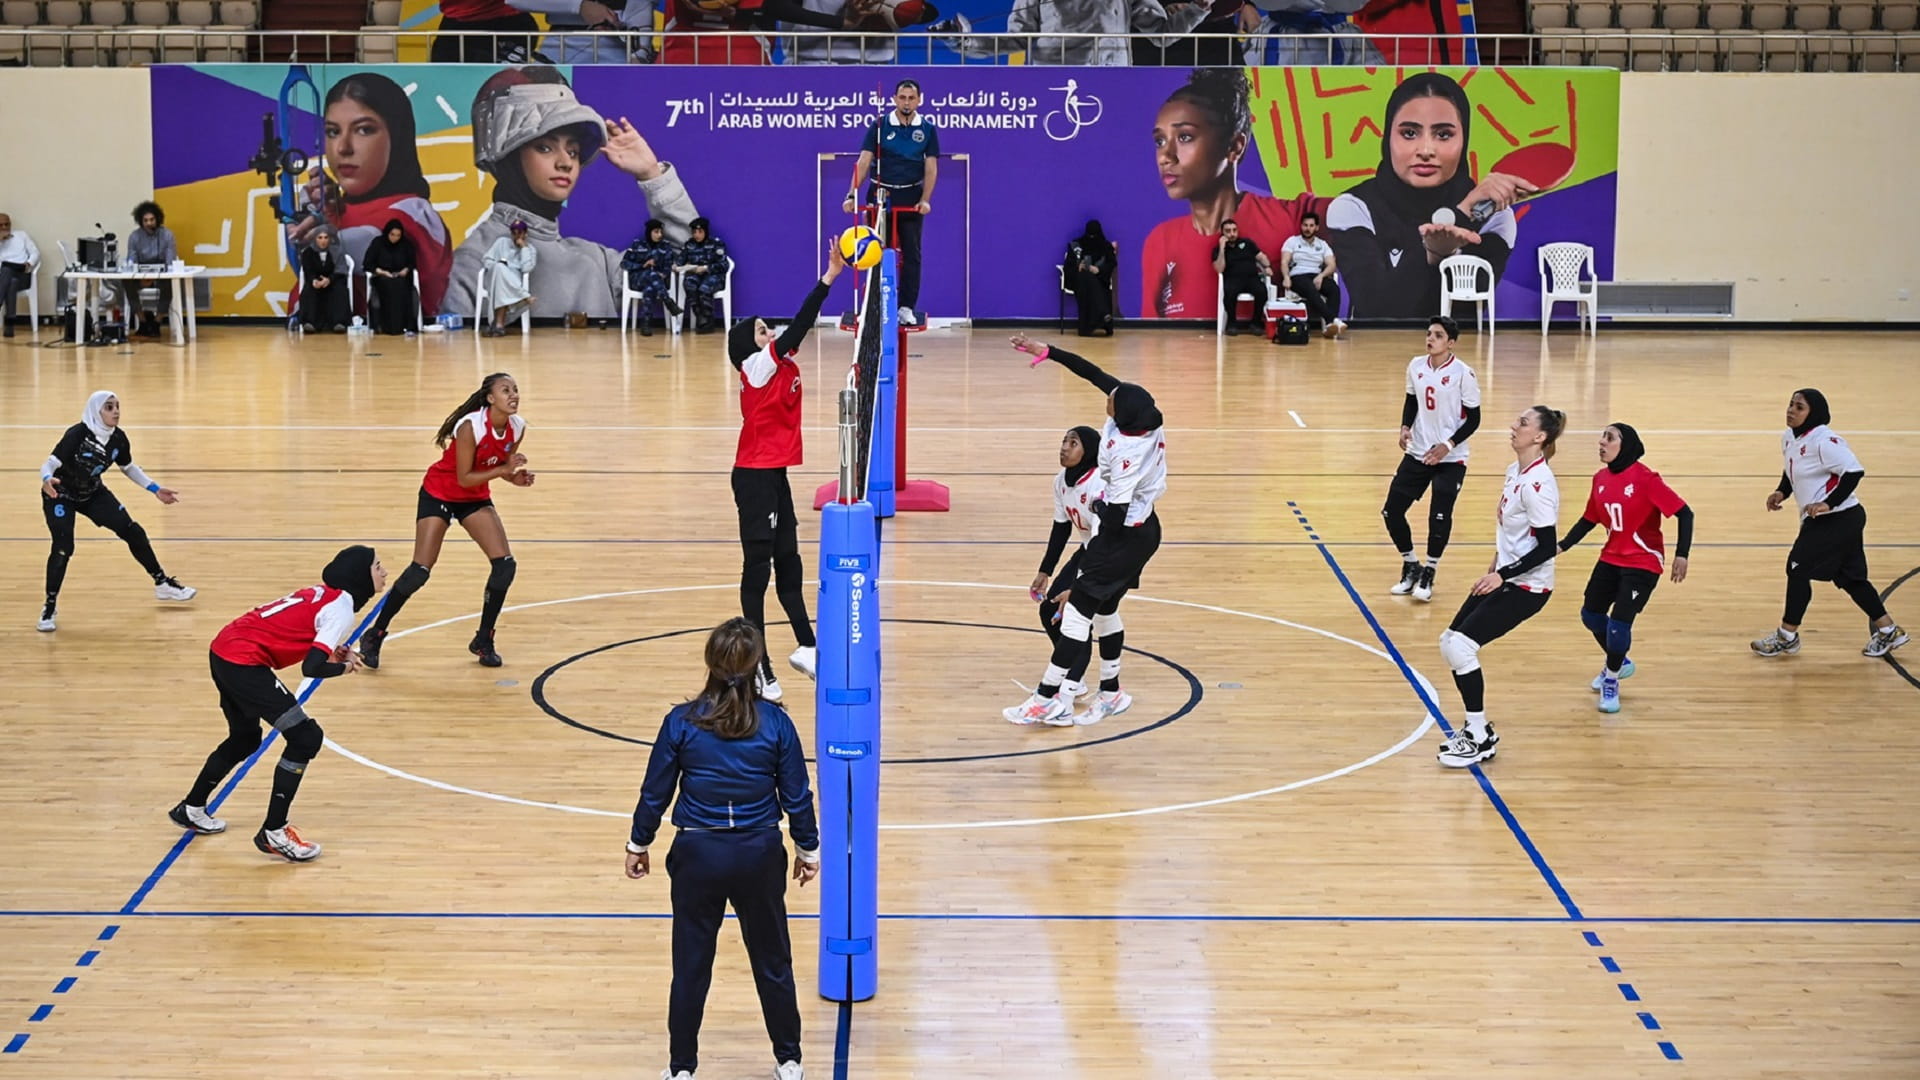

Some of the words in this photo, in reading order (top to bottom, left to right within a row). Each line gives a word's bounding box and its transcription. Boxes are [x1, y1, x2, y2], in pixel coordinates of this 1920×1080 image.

[720, 92, 798, 111] للسيدات
[804, 91, 863, 111] العربية
[931, 91, 995, 111] الألعاب
[1000, 91, 1037, 111] دورة
[665, 99, 704, 127] 7th
[718, 113, 763, 128] ARAB
[767, 113, 836, 128] WOMEN
[1425, 386, 1436, 411] 6
[54, 503, 66, 517] 6
[1065, 506, 1089, 531] 12
[1604, 502, 1623, 532] 10
[839, 558, 860, 567] FIVB
[851, 588, 862, 644] Senoh
